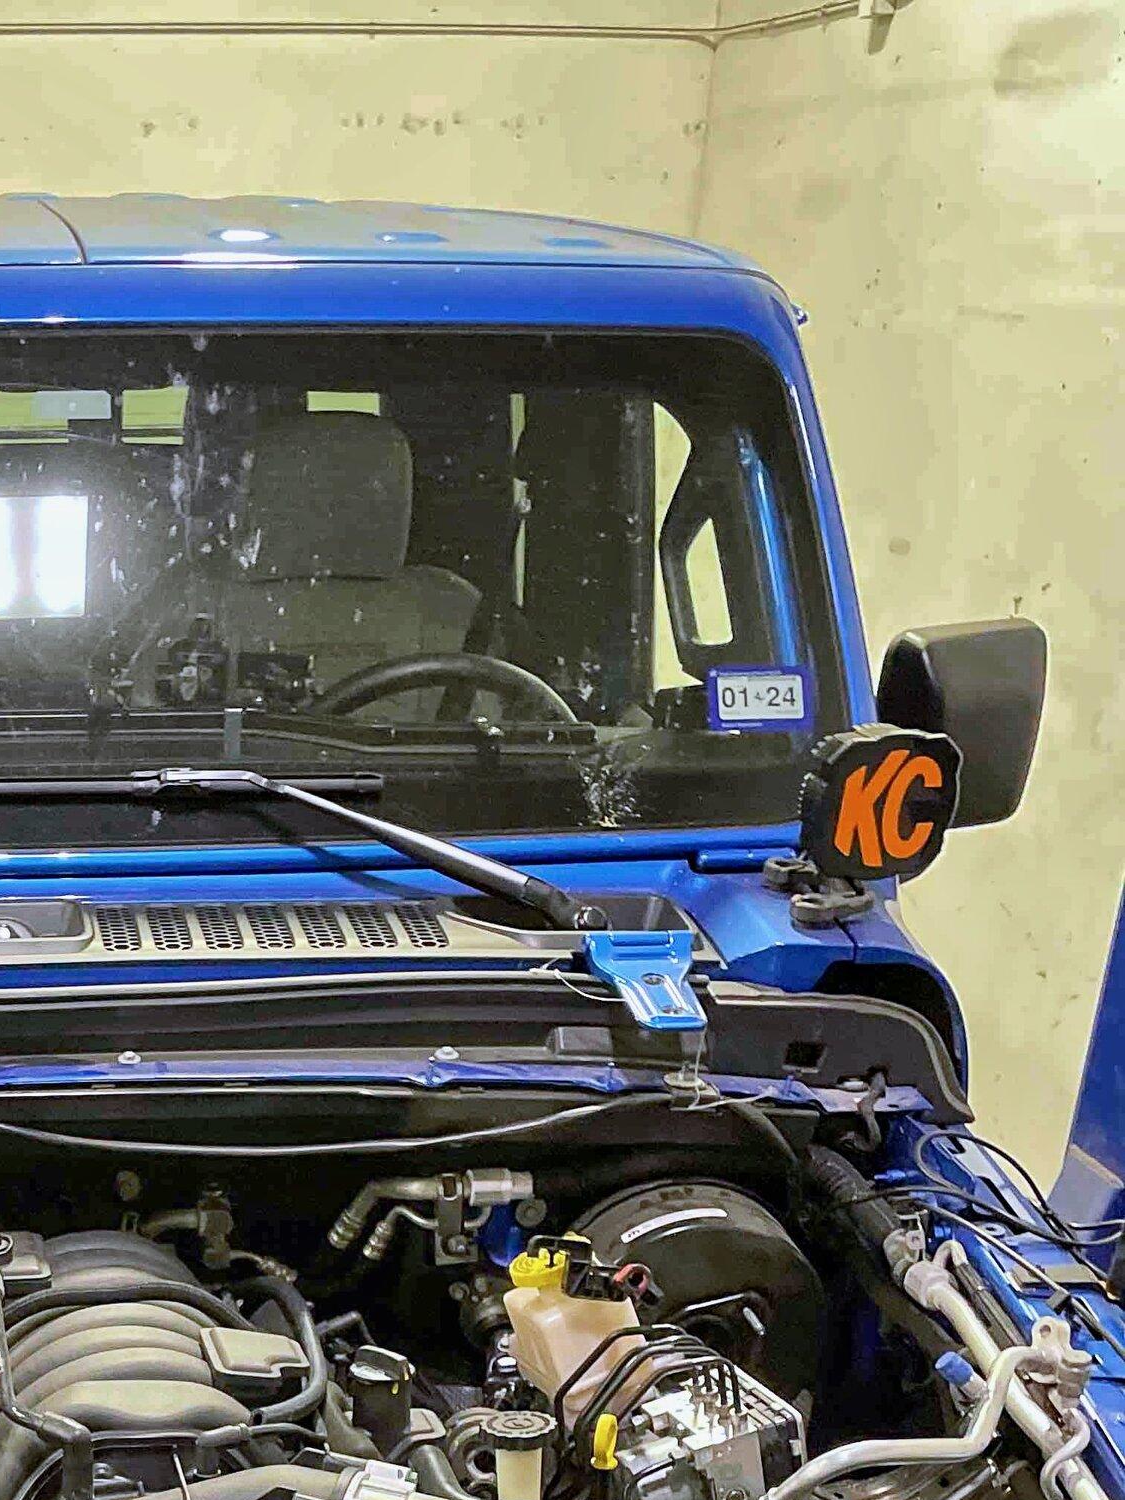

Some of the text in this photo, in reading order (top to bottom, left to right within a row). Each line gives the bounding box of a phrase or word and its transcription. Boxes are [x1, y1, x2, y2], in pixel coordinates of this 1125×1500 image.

[721, 686, 796, 708] 01 24
[834, 749, 943, 867] KC
